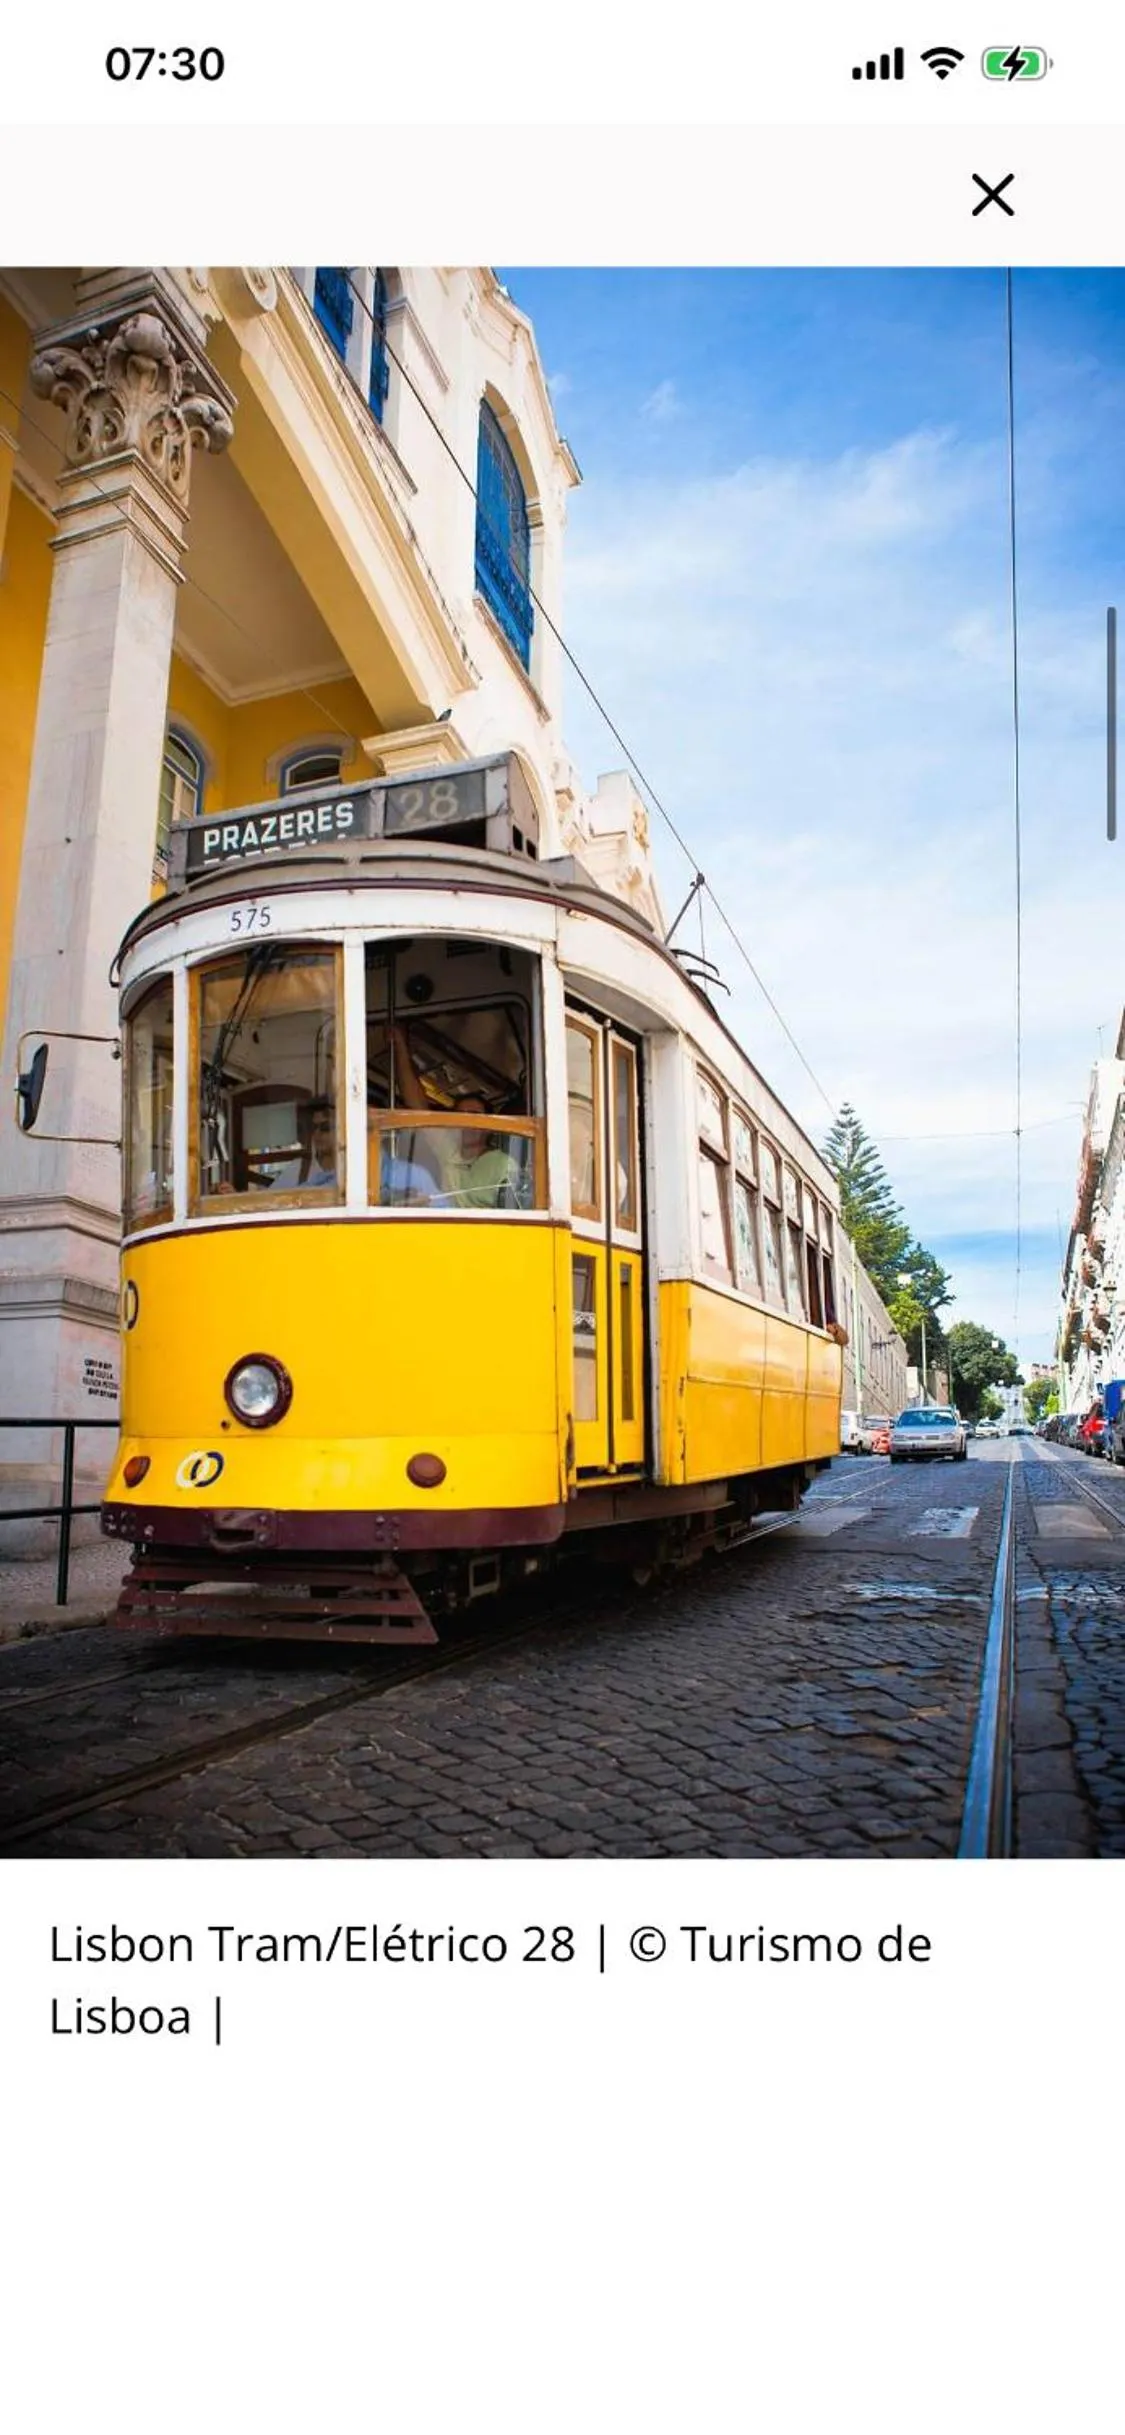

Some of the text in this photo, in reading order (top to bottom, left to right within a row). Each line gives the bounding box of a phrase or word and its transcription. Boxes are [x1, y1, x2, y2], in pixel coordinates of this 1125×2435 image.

[400, 780, 460, 825] 28
[202, 800, 355, 855] PRAZERES
[229, 905, 272, 932] 575
